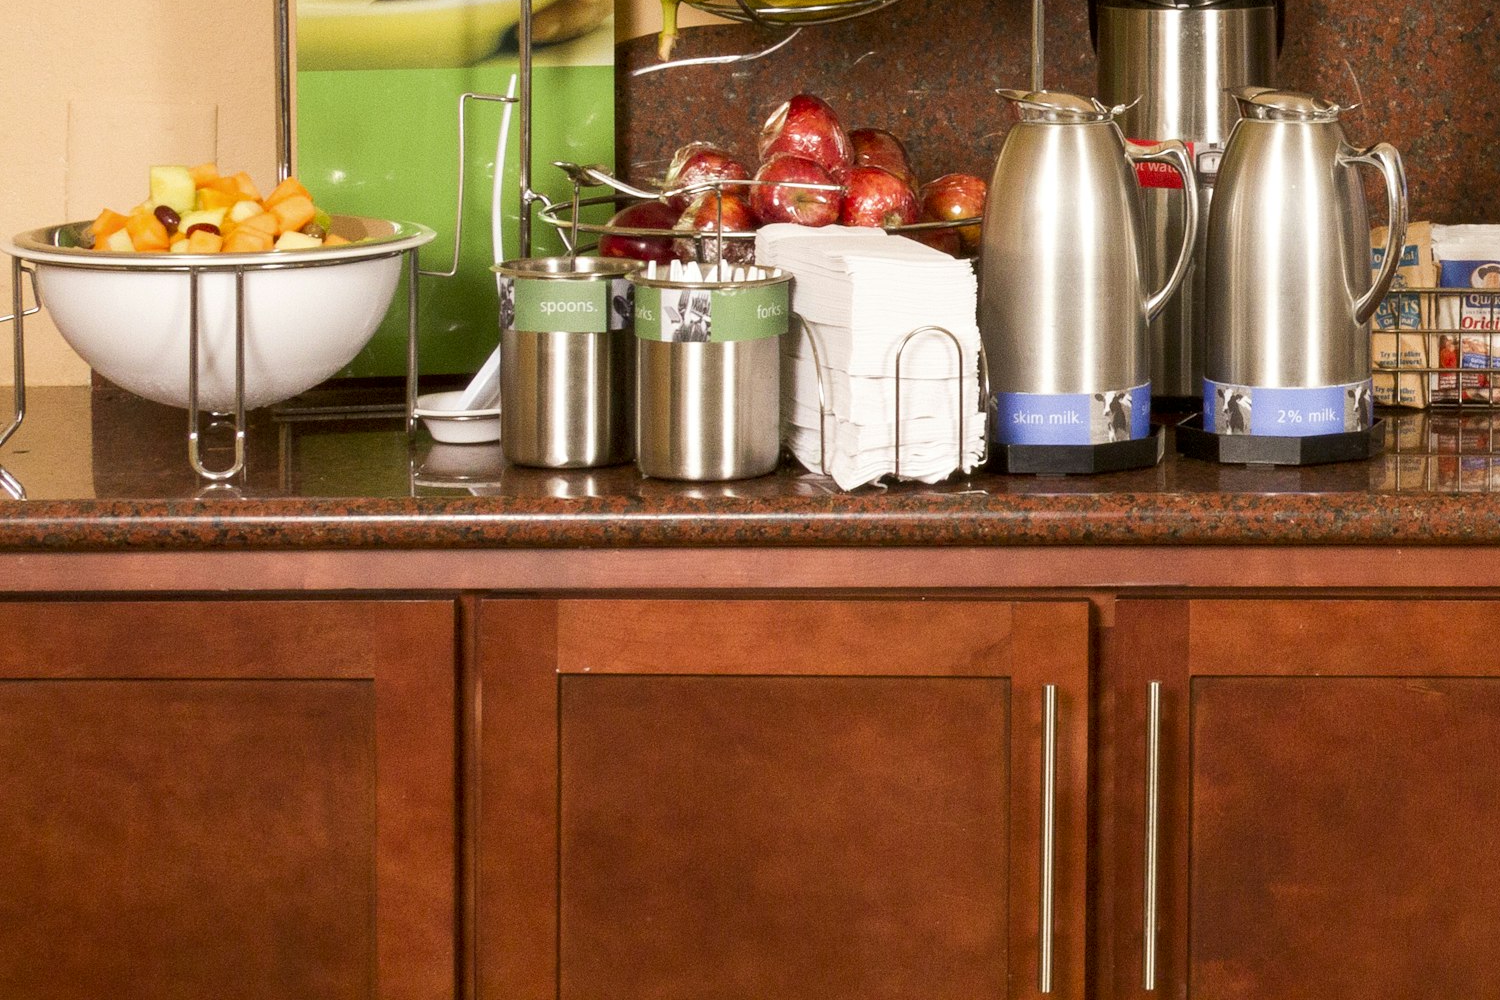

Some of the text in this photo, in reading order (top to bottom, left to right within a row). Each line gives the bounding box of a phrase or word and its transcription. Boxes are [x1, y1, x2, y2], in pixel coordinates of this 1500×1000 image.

[1135, 162, 1145, 171] ot
[540, 299, 598, 316] spoons.
[757, 303, 784, 319] forks.
[1013, 410, 1084, 425] skim milk.
[1277, 408, 1340, 424] 2% milk.
